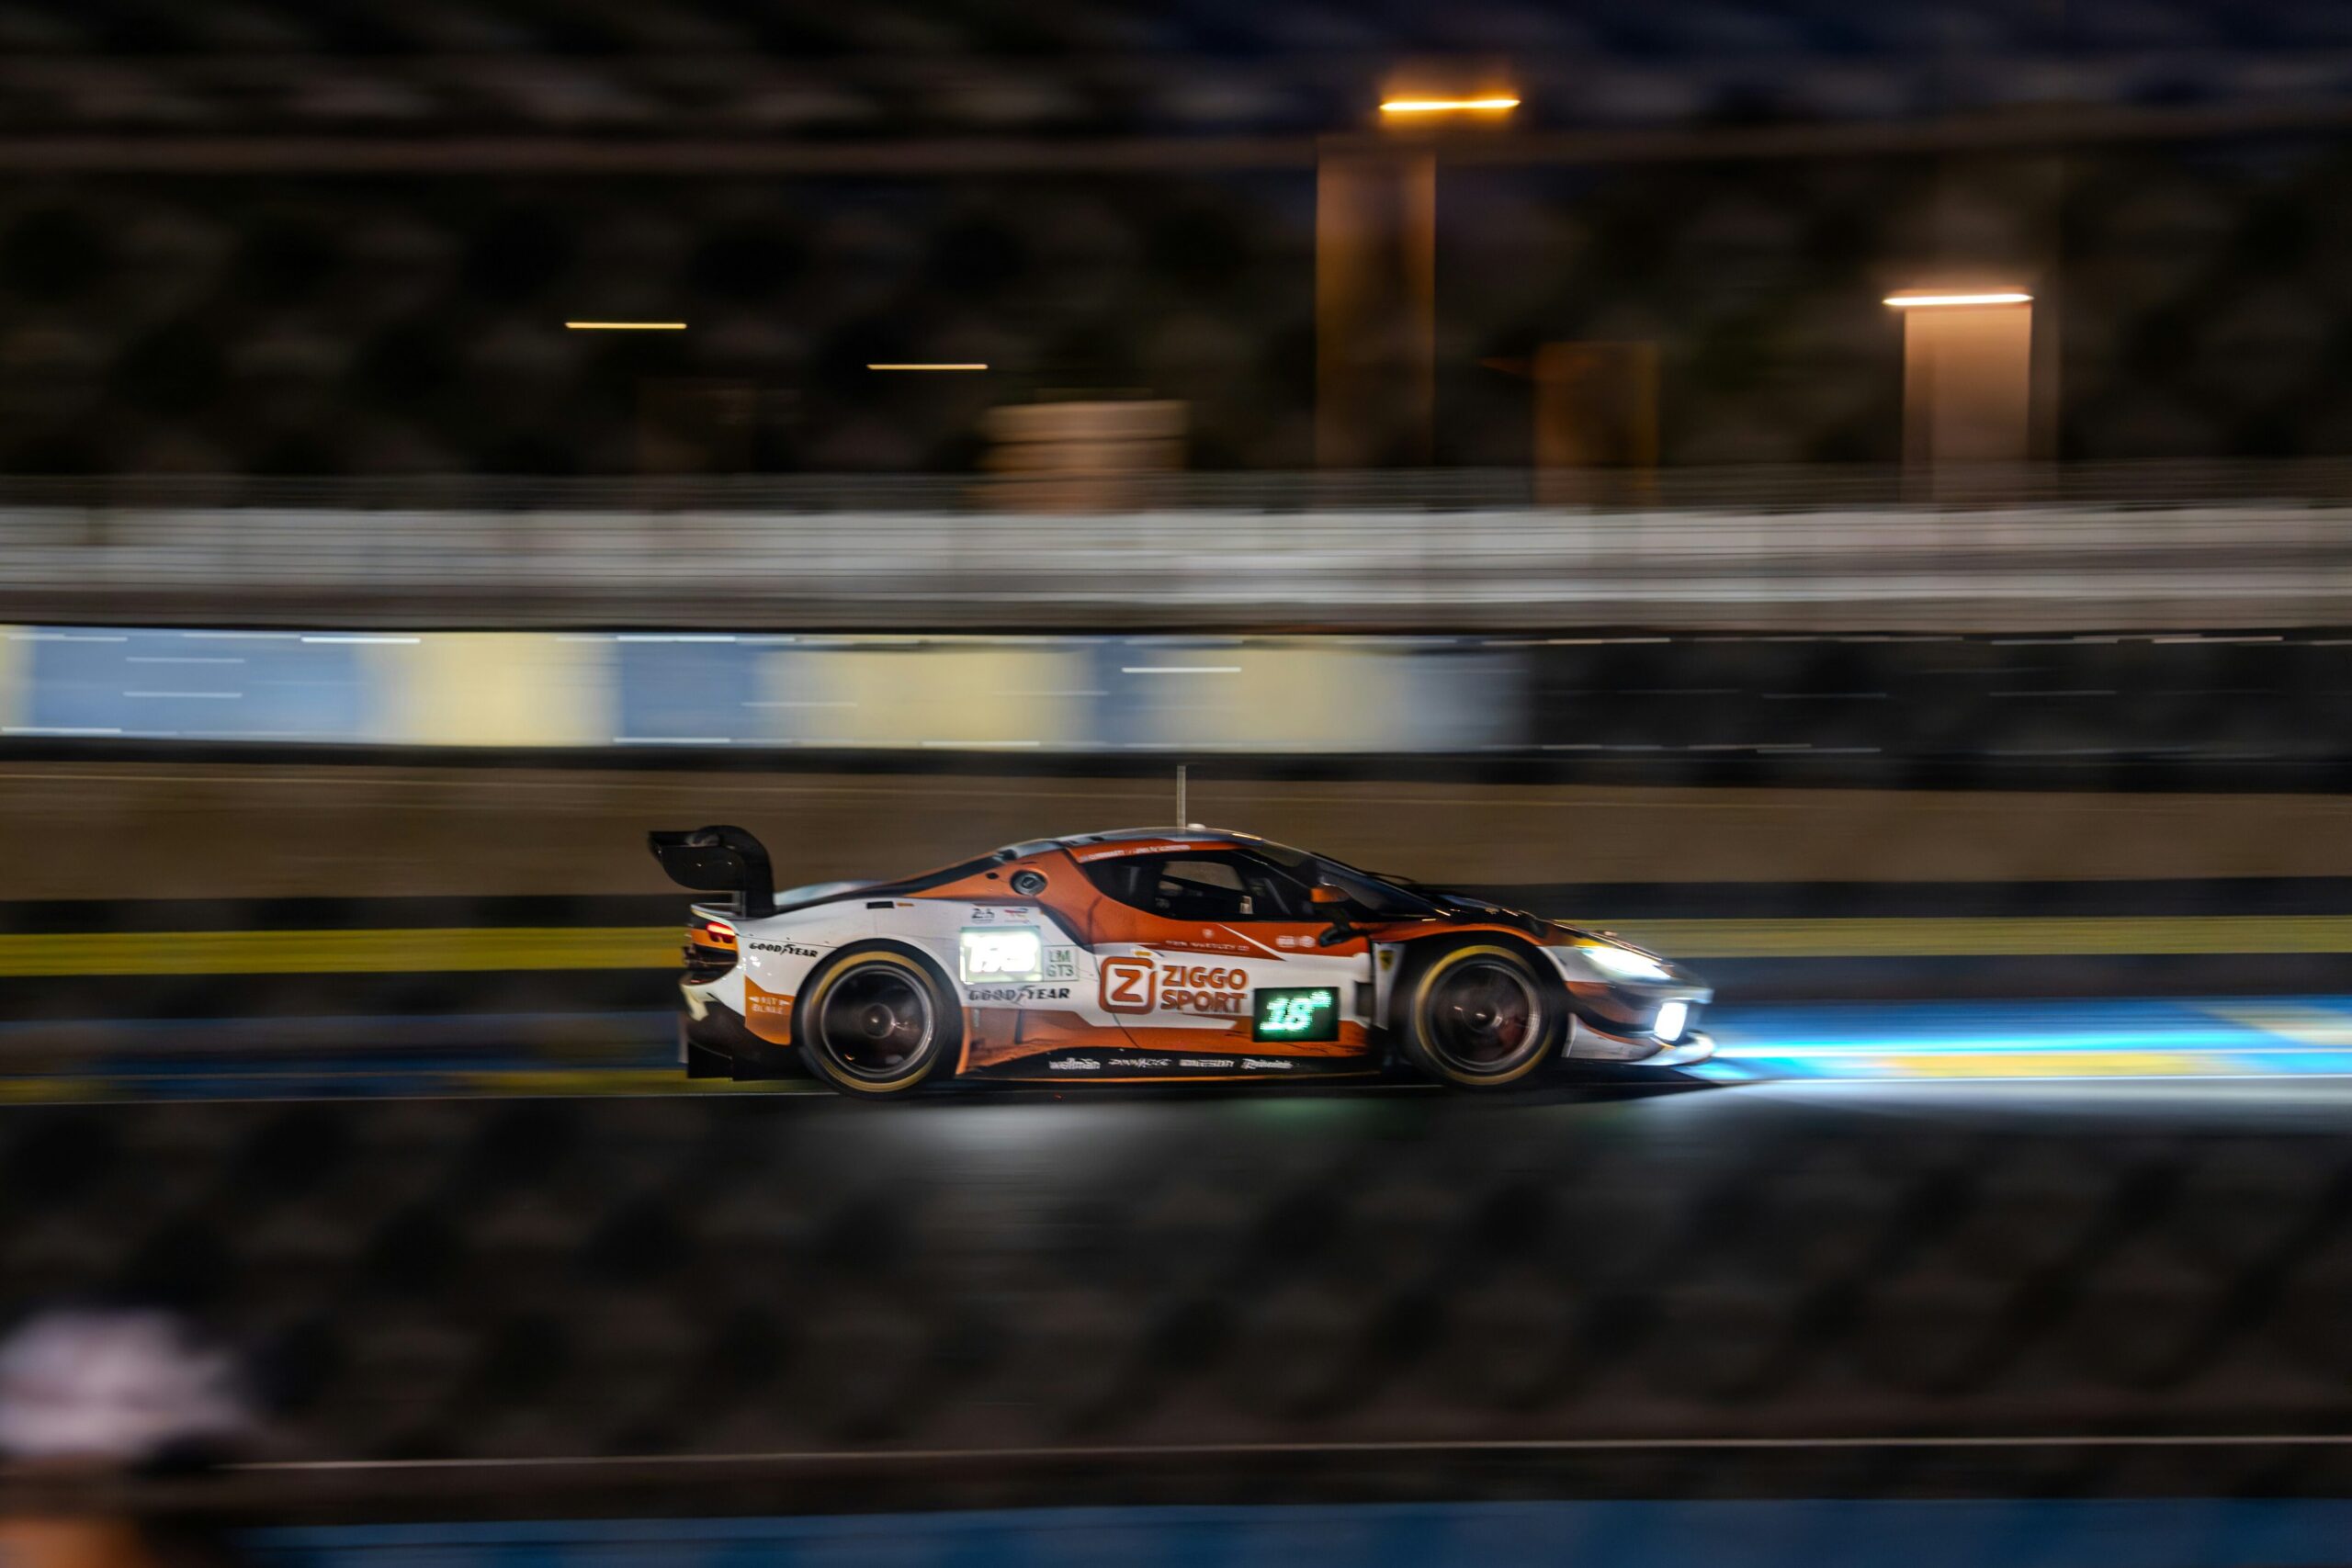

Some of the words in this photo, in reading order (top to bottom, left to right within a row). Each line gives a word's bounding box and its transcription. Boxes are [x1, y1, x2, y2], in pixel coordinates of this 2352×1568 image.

[749, 942, 819, 957] GOODYEAR
[1161, 964, 1249, 990] ZIGGO
[968, 985, 1071, 1005] GOODYEAR
[1159, 989, 1248, 1013] SPORT
